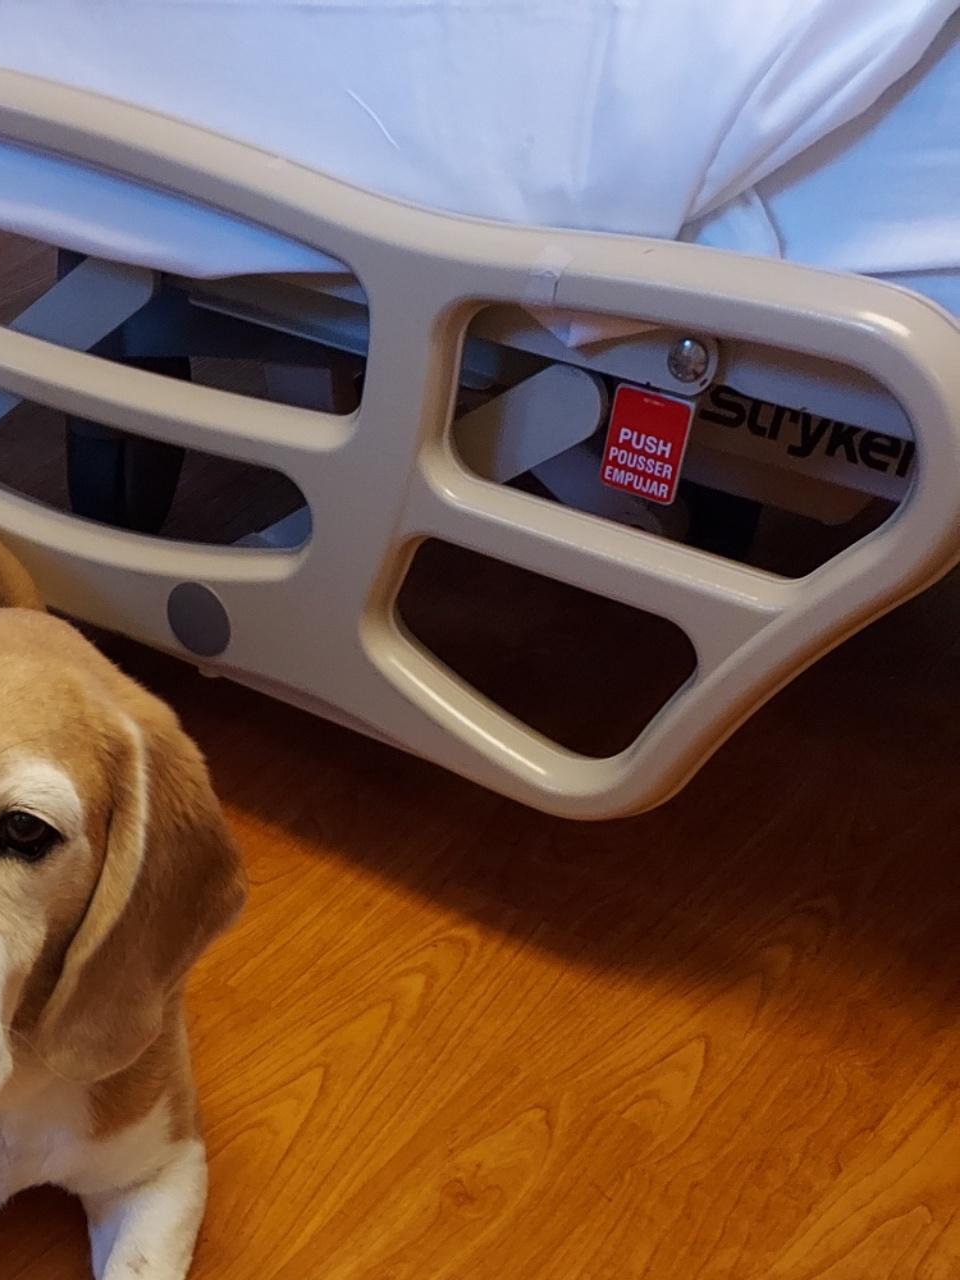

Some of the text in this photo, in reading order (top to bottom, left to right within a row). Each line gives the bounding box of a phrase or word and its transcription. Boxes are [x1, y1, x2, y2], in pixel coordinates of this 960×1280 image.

[619, 427, 672, 458] PUSH
[609, 446, 672, 480] POUSSER
[604, 465, 669, 499] EMPUJAR
